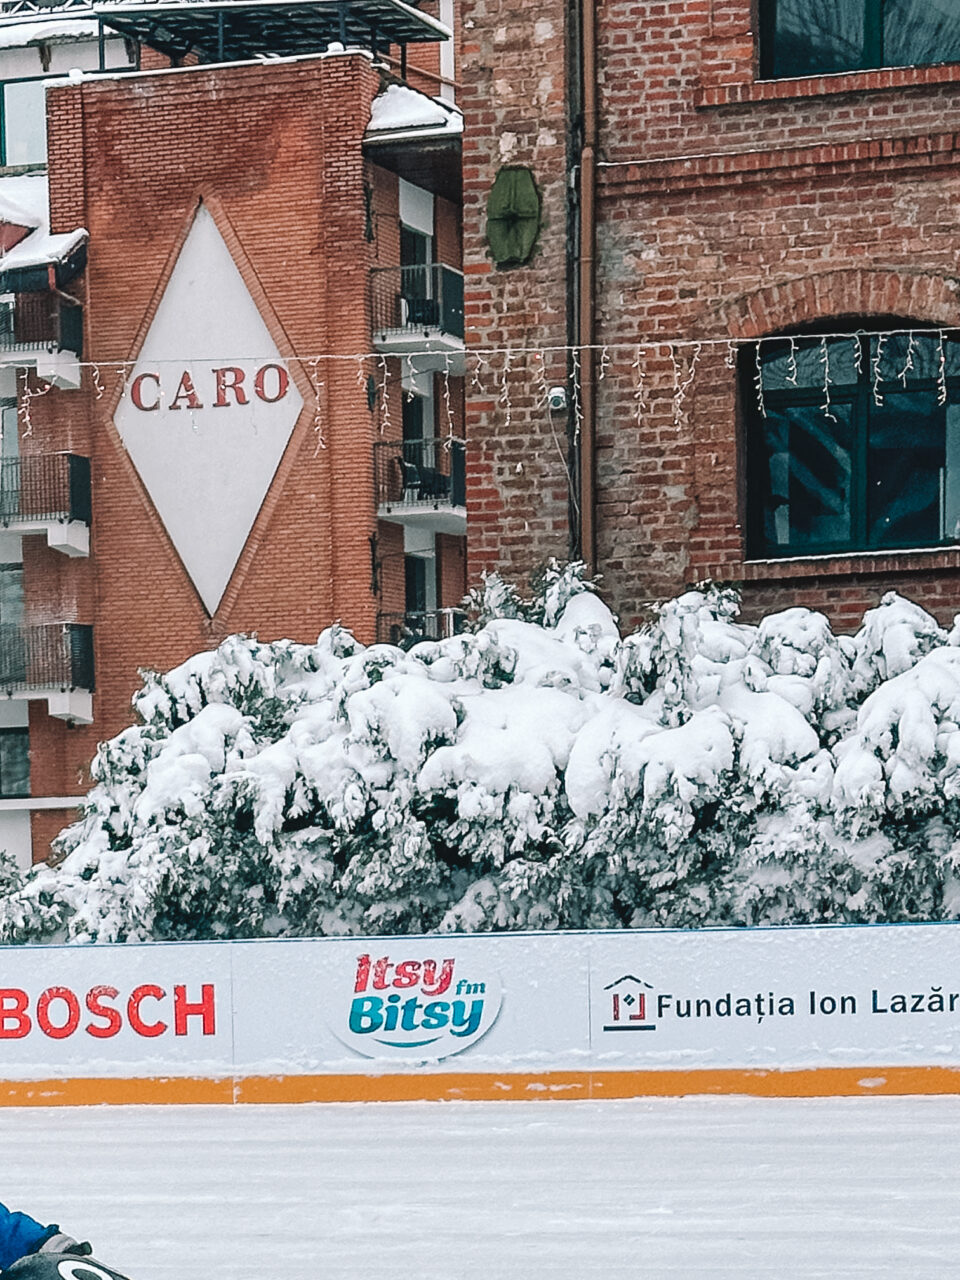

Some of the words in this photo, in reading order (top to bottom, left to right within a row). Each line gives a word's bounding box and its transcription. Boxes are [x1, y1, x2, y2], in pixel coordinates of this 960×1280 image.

[131, 363, 290, 412] CARO
[354, 954, 455, 996] Itsy
[456, 980, 486, 996] fm
[349, 994, 484, 1038] Bitsy
[657, 993, 795, 1024] Fundația
[810, 991, 857, 1016] Ion
[872, 986, 960, 1014] Lazăr
